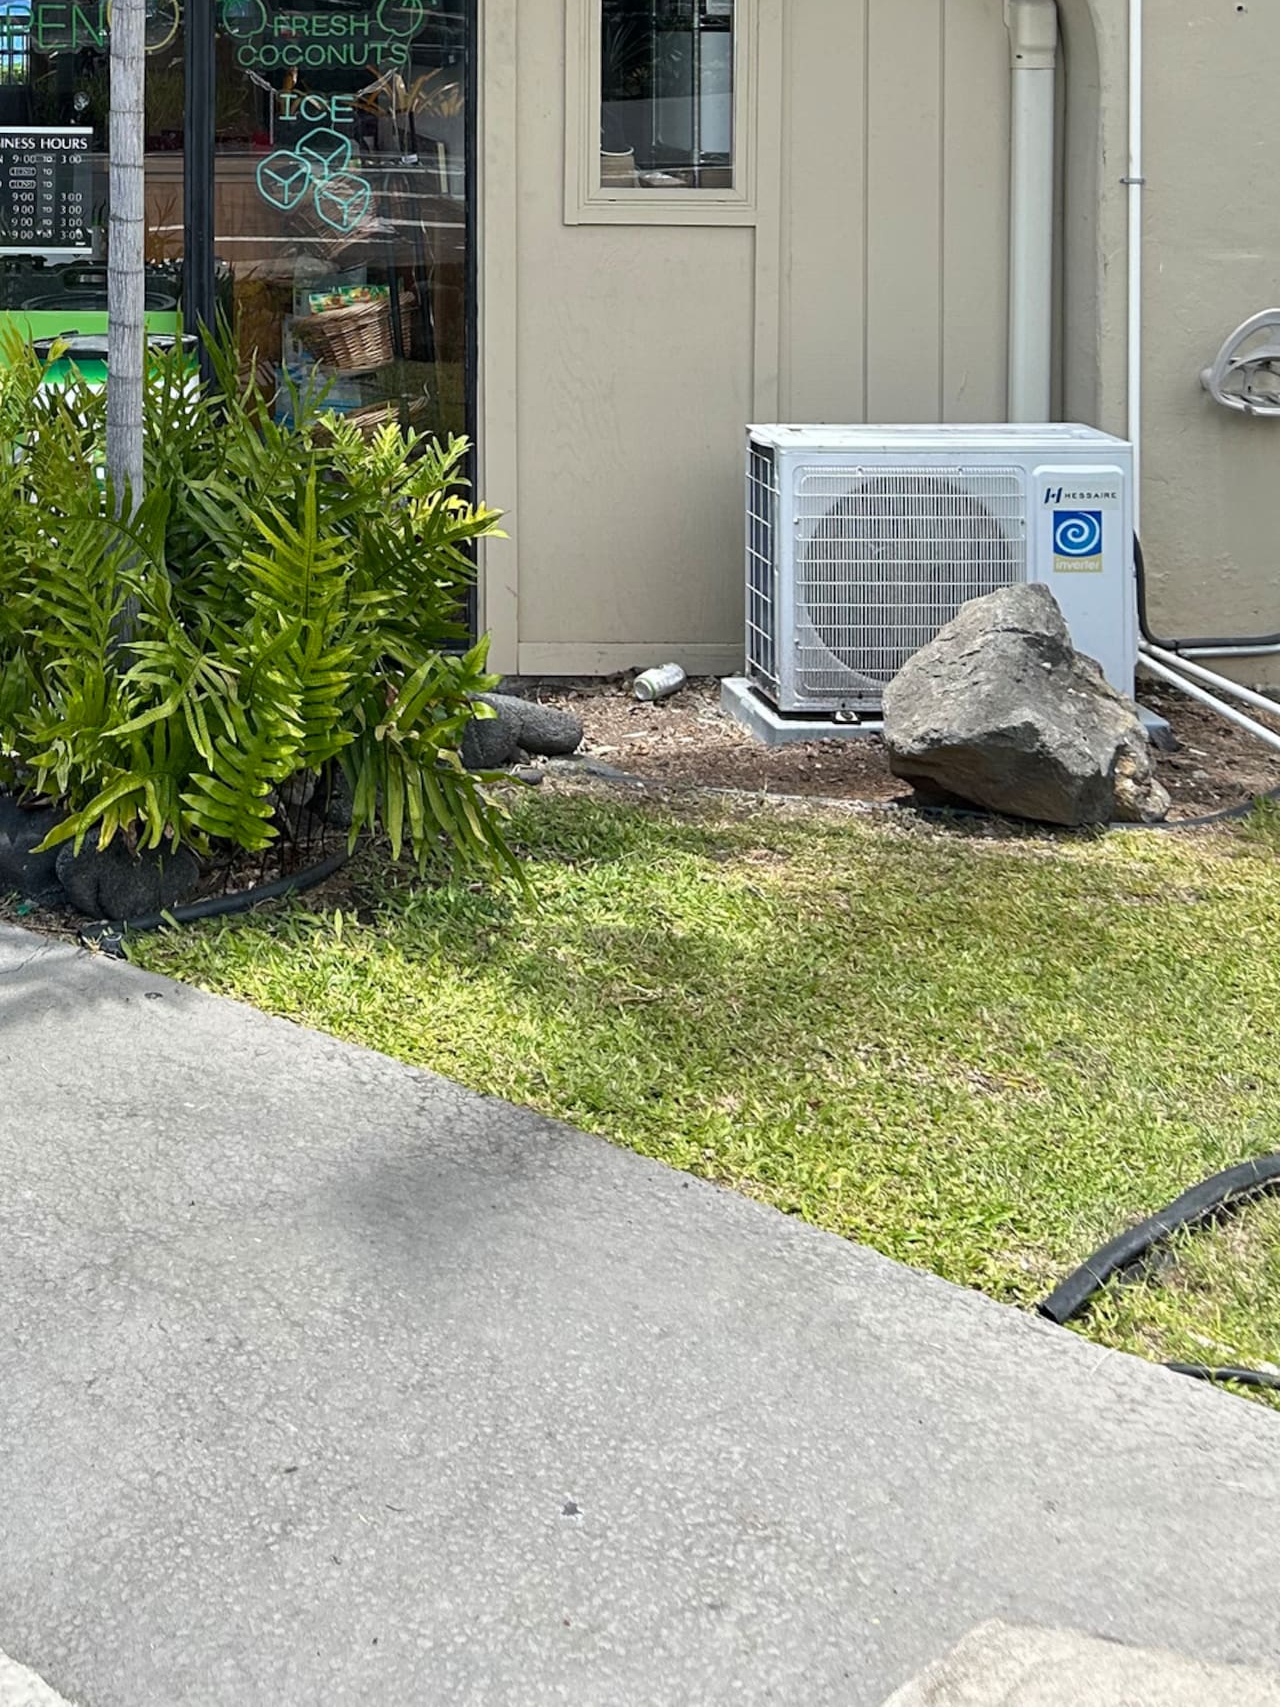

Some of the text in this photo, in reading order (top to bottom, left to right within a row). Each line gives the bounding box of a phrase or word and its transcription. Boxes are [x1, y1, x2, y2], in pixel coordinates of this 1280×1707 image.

[273, 13, 369, 37] FRESH
[237, 43, 409, 66] COCONUTS
[279, 94, 355, 122] ICE
[40, 137, 88, 150] HOURS
[1064, 492, 1117, 500] HESSAIRE
[1055, 557, 1100, 571] inverter
